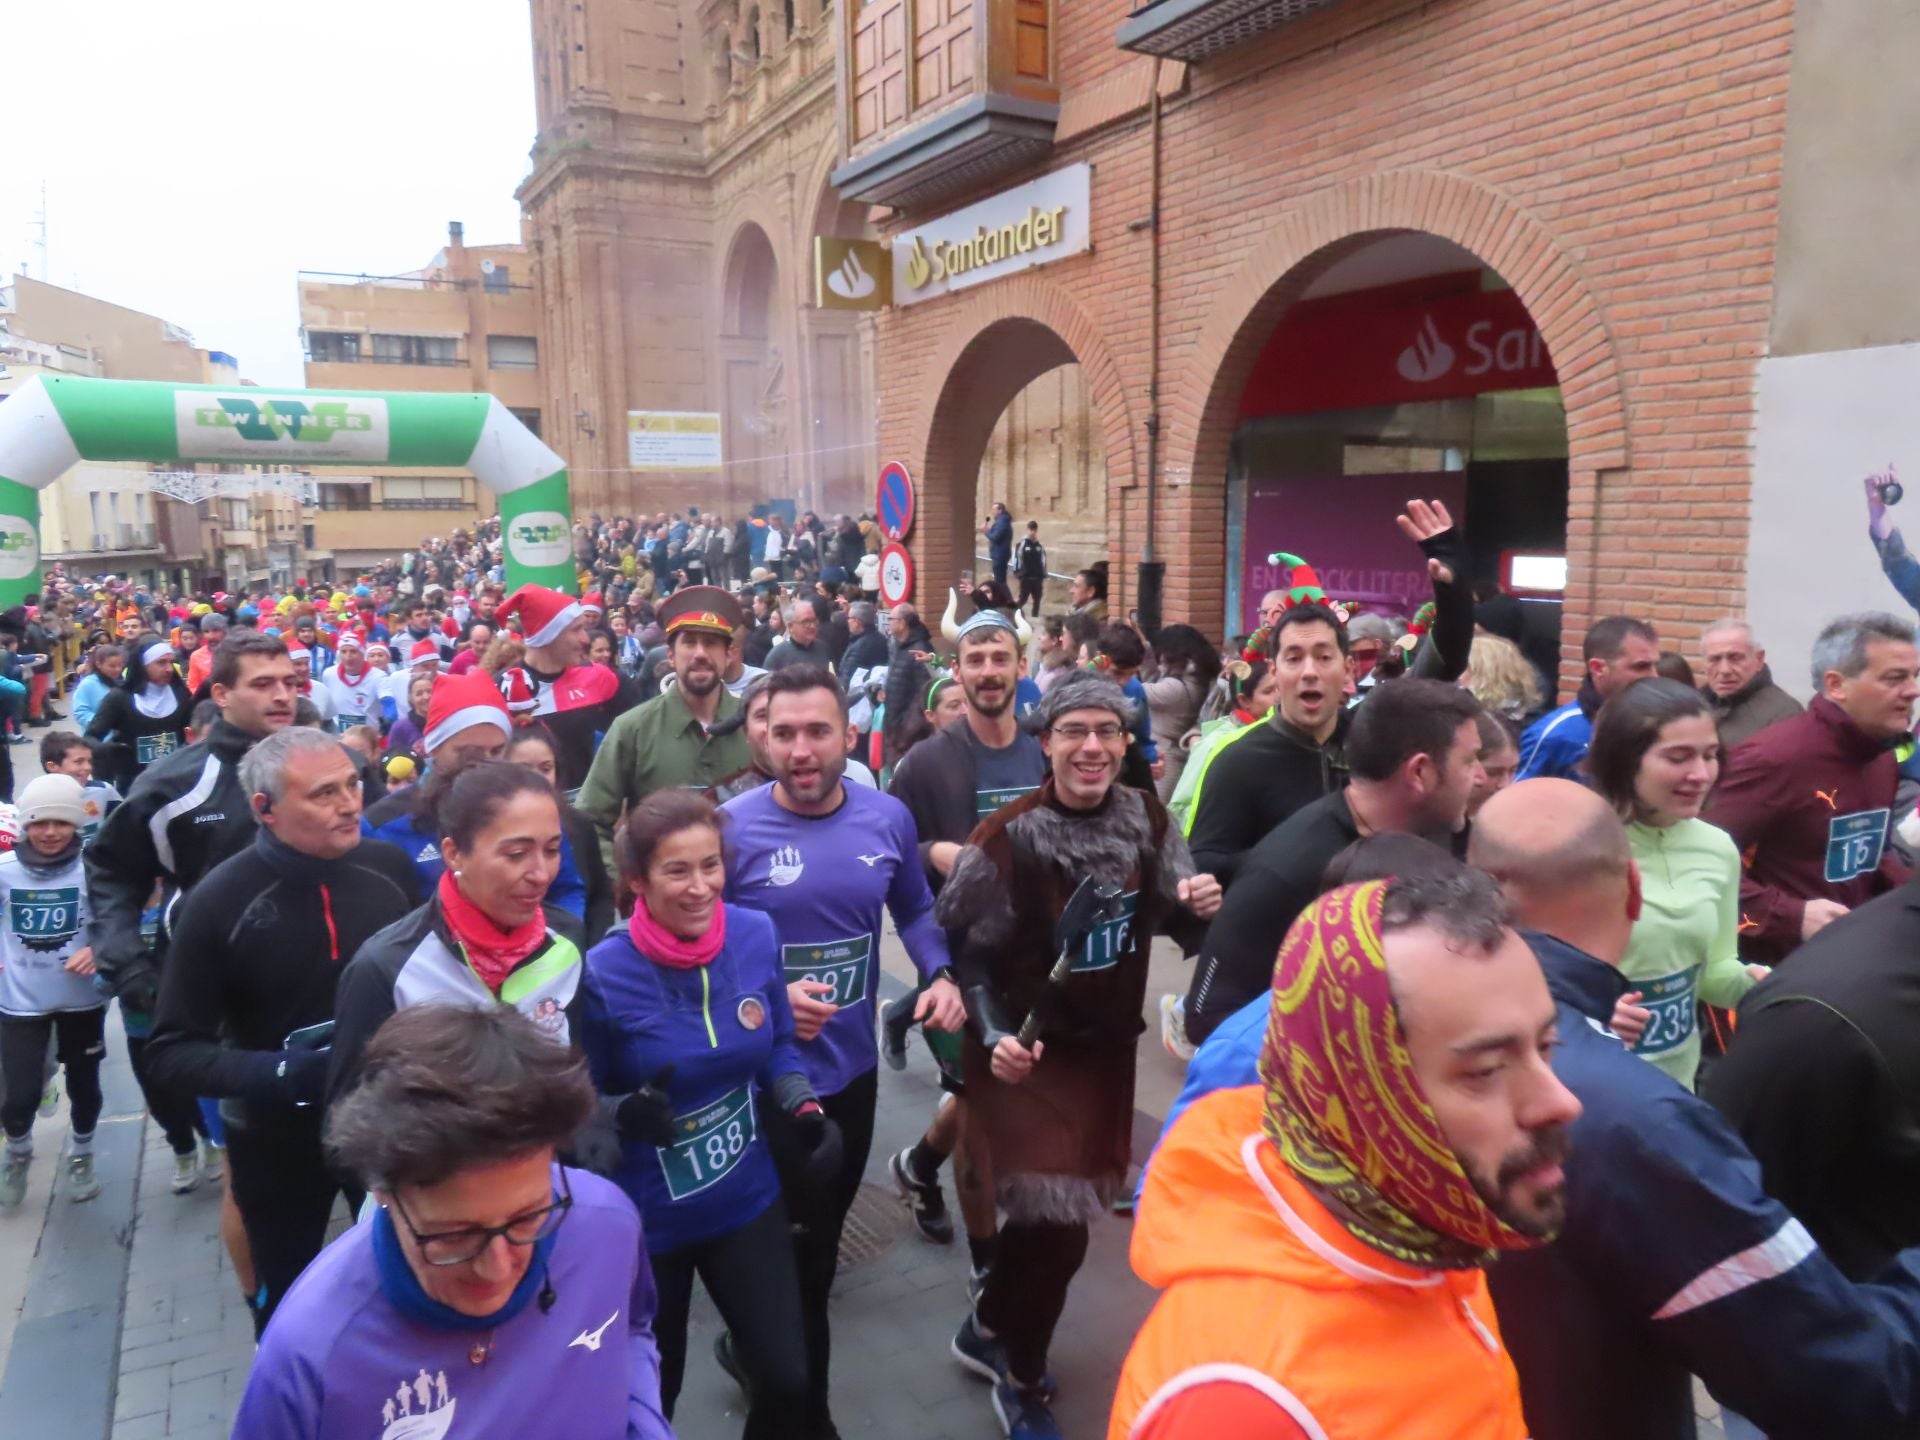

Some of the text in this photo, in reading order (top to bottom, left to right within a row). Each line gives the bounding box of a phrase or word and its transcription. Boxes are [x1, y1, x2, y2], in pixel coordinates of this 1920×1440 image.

[931, 206, 1066, 282] Santander
[202, 410, 363, 428] TWINNER
[1251, 566, 1278, 590] EN
[1282, 567, 1351, 593] SOCK
[21, 907, 67, 931] 379
[1643, 995, 1690, 1046] 235
[683, 1121, 744, 1181] 188
